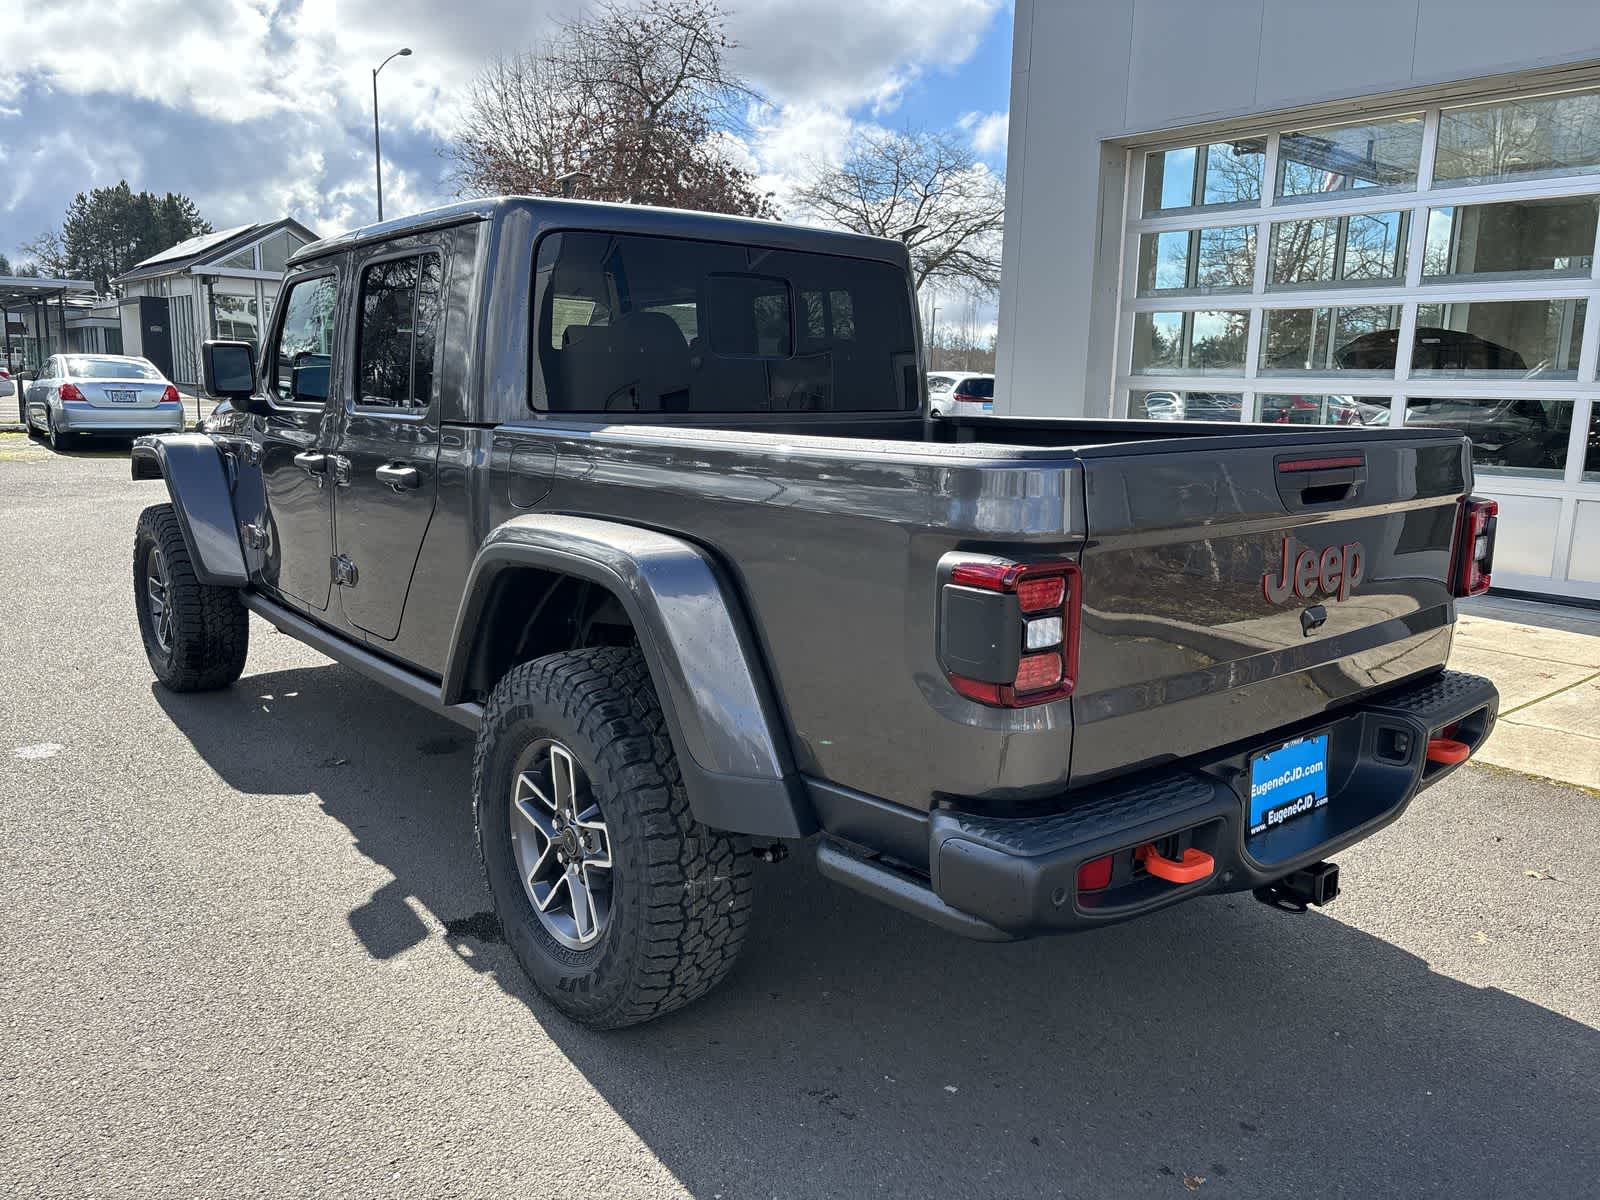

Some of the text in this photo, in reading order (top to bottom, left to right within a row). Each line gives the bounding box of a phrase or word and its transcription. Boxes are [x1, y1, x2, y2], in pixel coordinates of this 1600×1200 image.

[1263, 536, 1365, 604] Jeep
[1251, 761, 1323, 797] EugeneCJD.com
[1268, 795, 1313, 825] EugeneCJD
